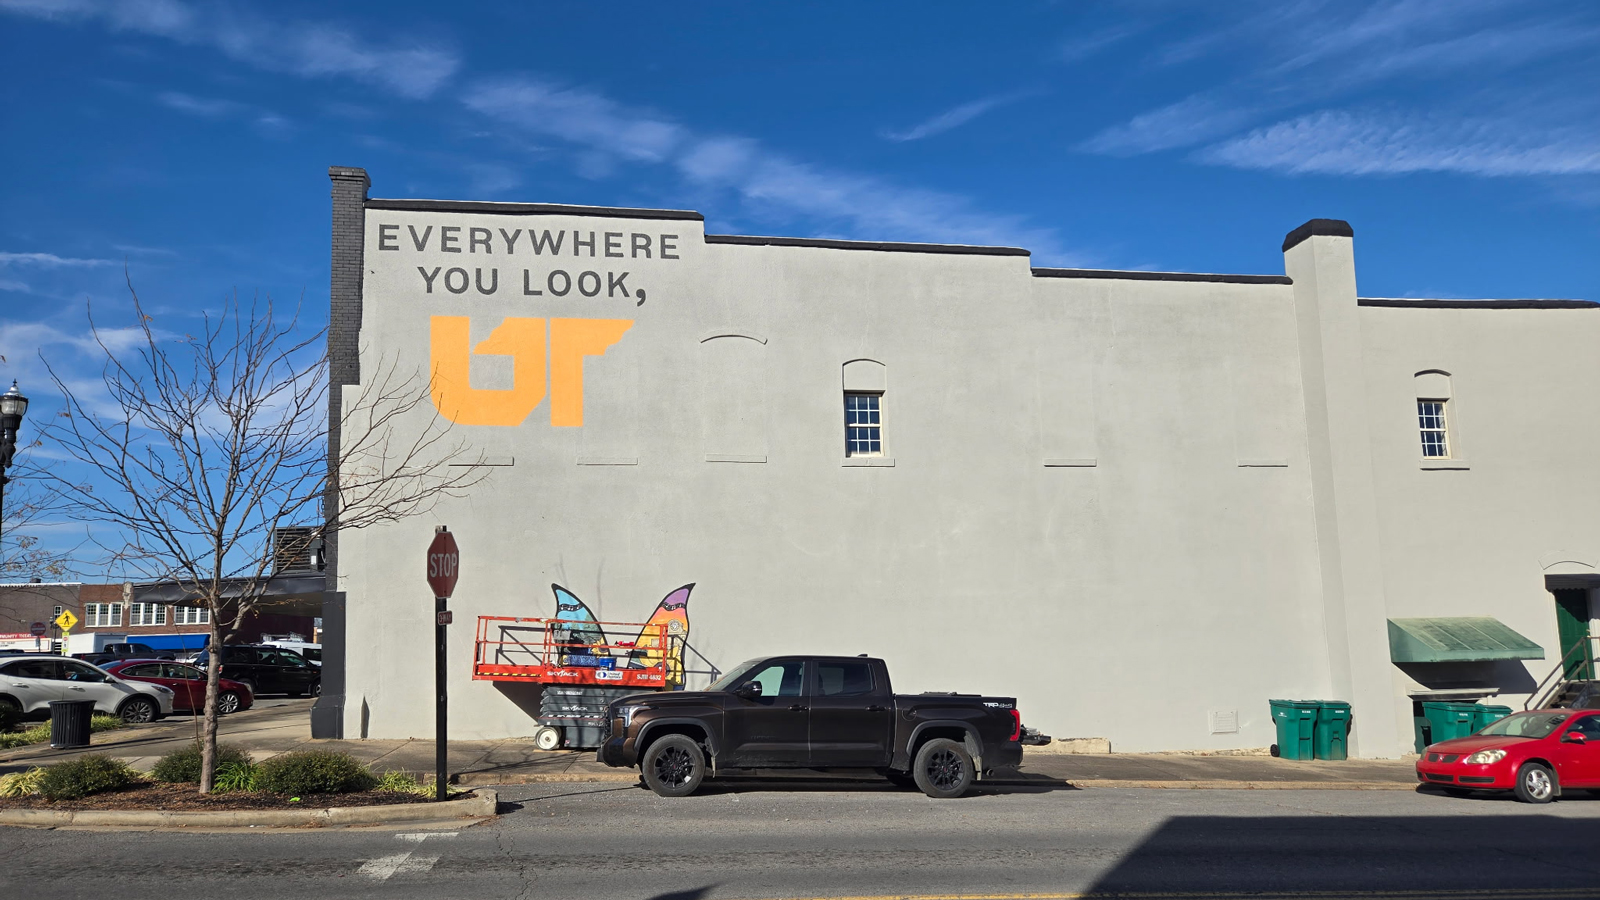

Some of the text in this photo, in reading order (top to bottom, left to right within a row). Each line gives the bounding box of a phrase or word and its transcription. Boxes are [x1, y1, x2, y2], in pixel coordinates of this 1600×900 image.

[378, 223, 680, 260] EVERYWHERE
[416, 266, 647, 308] YOU LOOK,
[429, 314, 636, 428] UT
[430, 553, 457, 578] STOP
